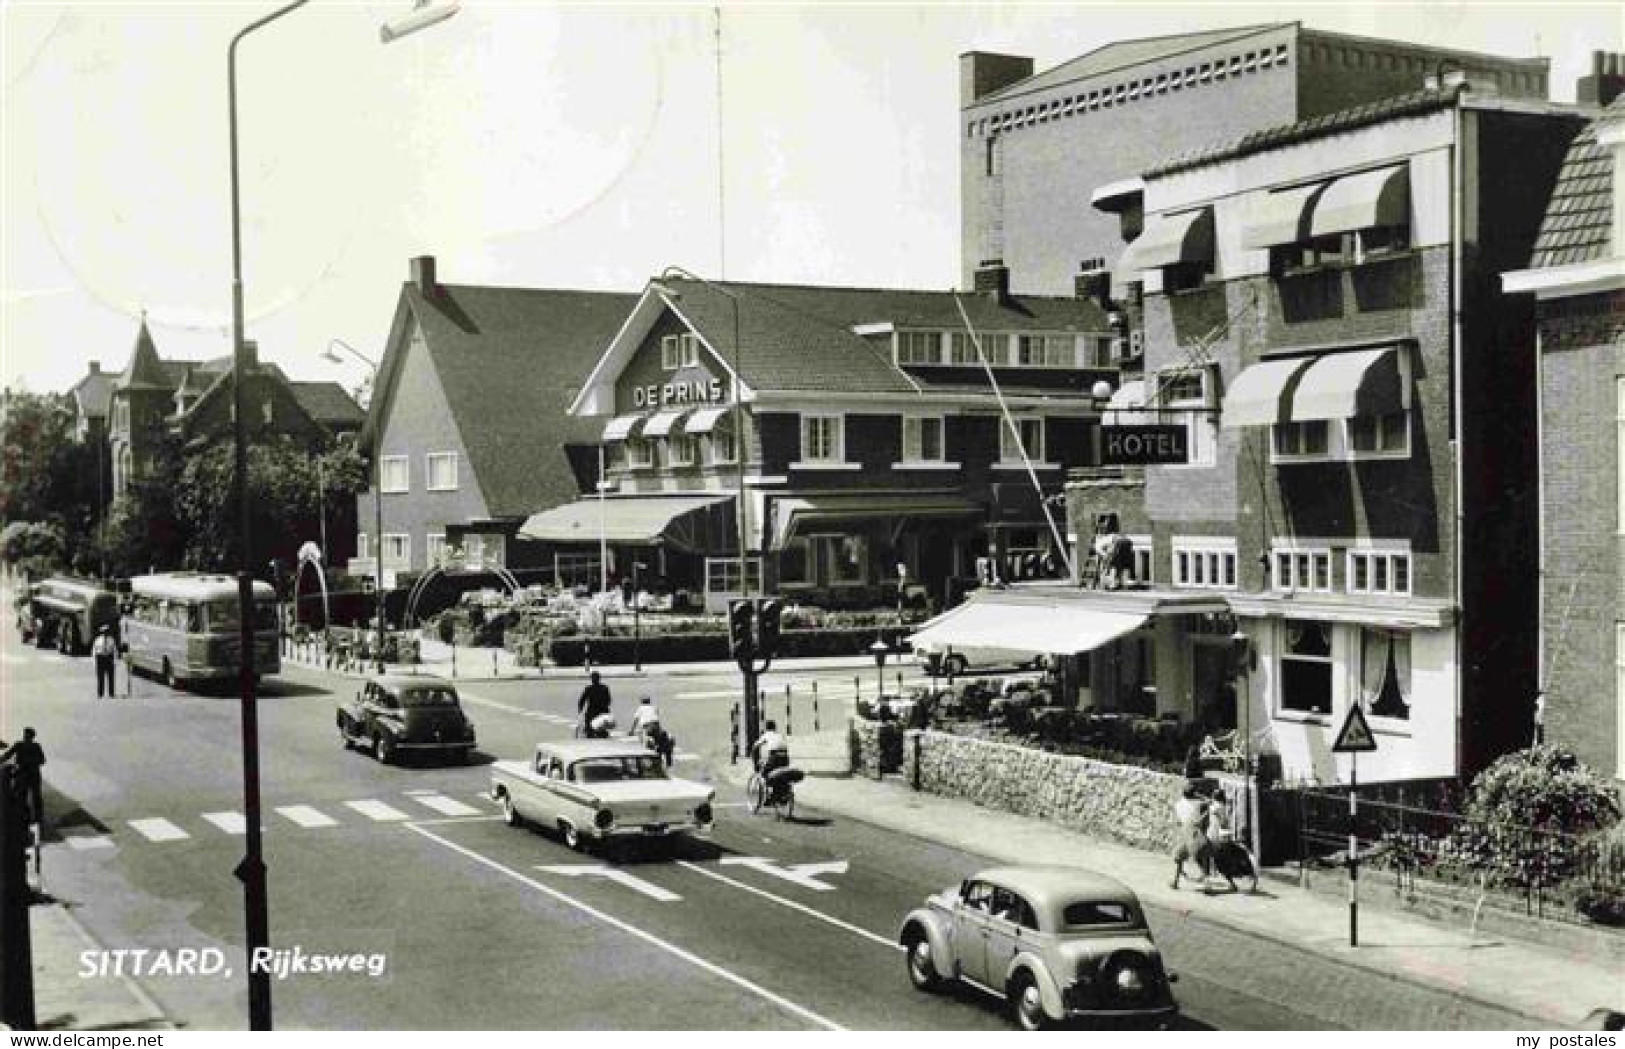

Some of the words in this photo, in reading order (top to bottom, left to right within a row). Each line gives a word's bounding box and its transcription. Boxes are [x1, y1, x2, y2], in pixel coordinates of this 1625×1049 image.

[634, 384, 658, 406] DE
[663, 378, 720, 405] PRINS
[1108, 432, 1184, 457] HOTEL
